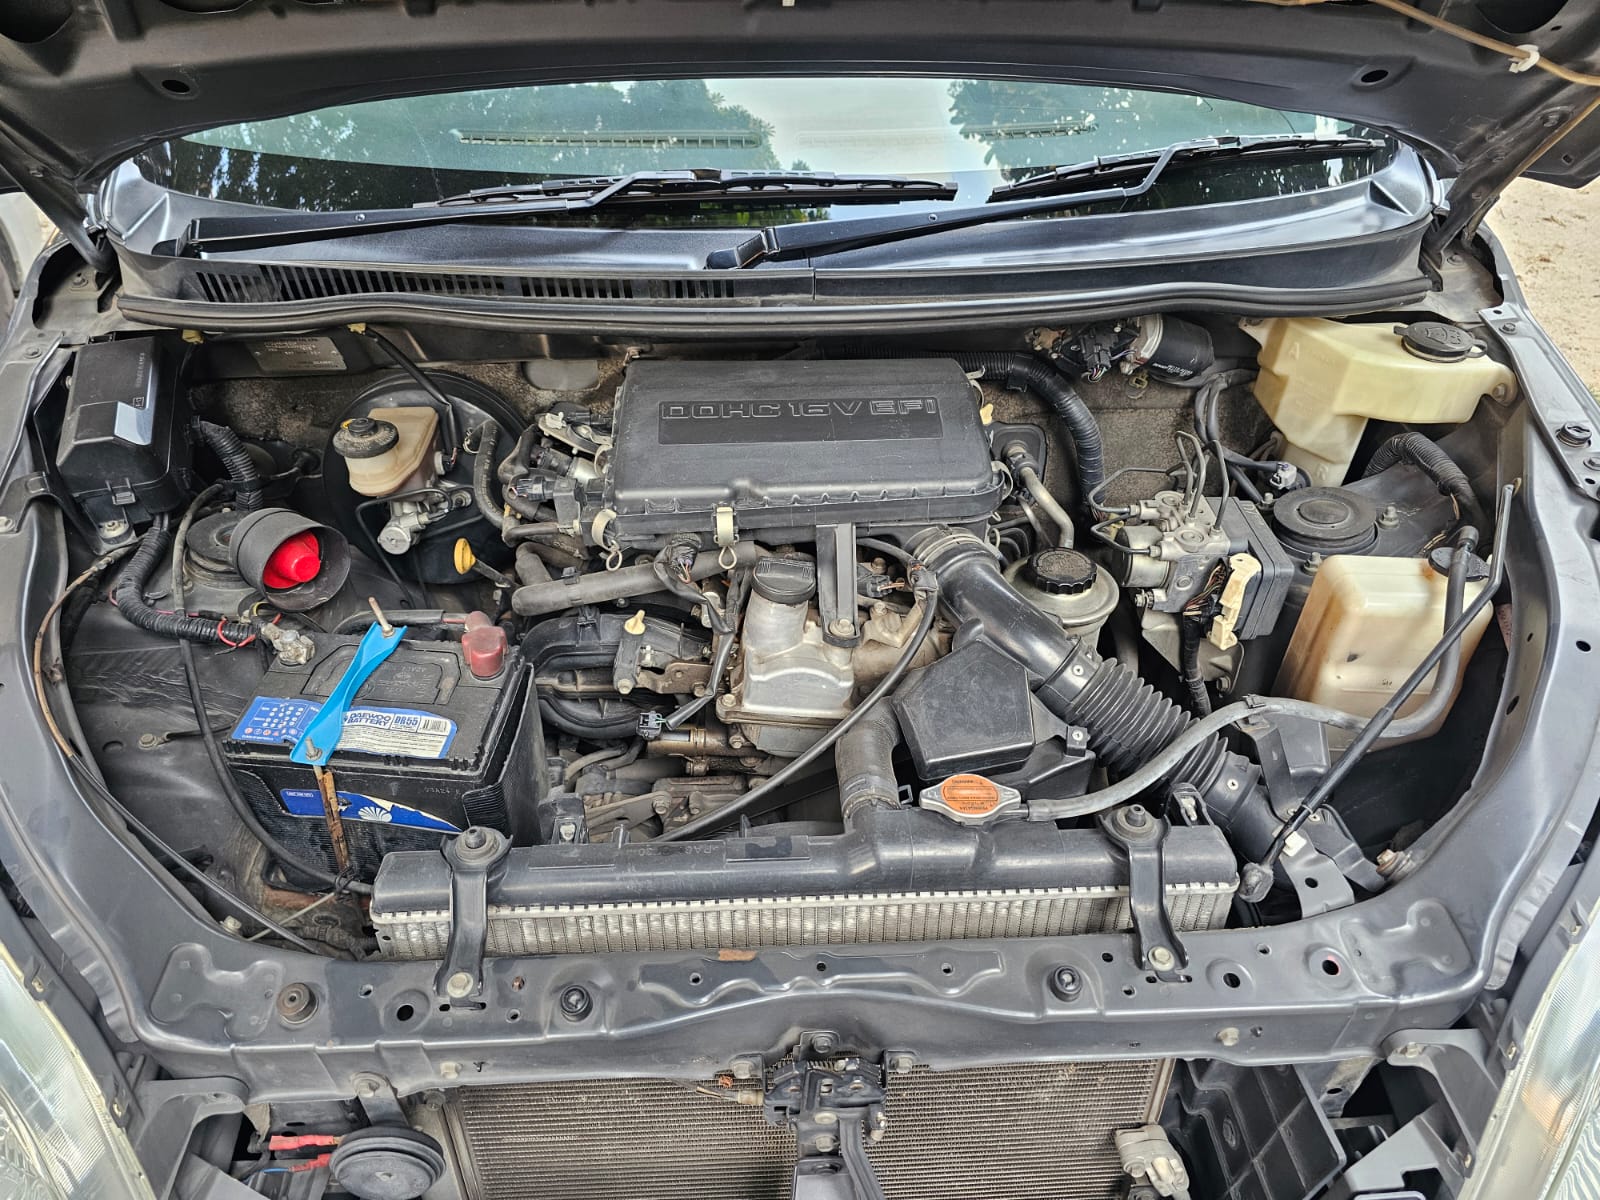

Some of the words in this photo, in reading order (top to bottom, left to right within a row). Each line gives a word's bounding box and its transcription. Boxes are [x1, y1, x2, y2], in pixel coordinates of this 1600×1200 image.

[661, 401, 781, 419] DOHC
[788, 400, 863, 416] 16V
[869, 399, 936, 415] EFI
[347, 718, 389, 726] BATTERY
[350, 713, 391, 722] DAEWOO
[394, 716, 418, 726] DR55
